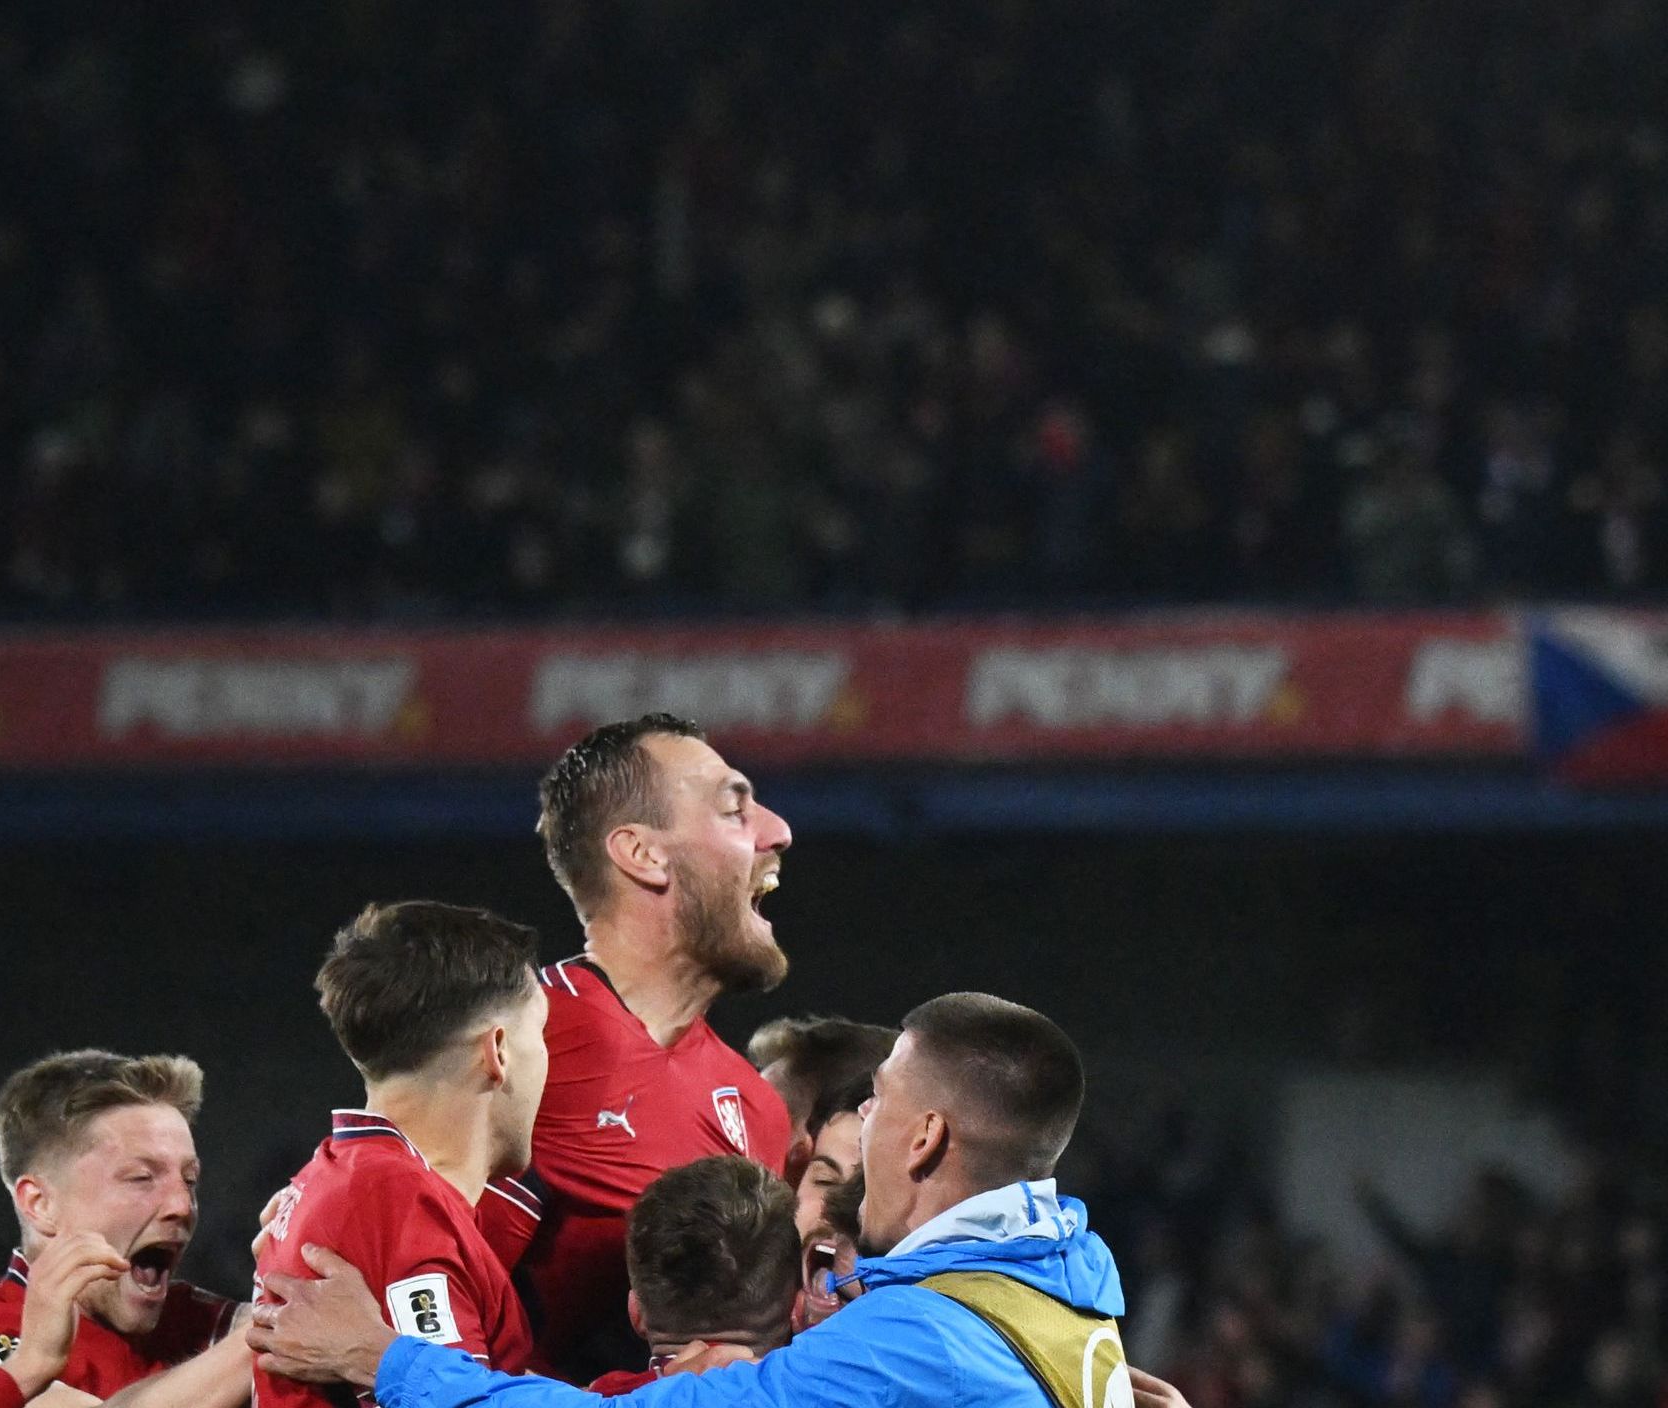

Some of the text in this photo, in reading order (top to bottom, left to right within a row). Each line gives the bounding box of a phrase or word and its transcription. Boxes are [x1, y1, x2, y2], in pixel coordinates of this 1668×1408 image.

[99, 654, 418, 737] PENNY
[532, 650, 854, 734] PENNY
[966, 640, 1290, 728] PENNY
